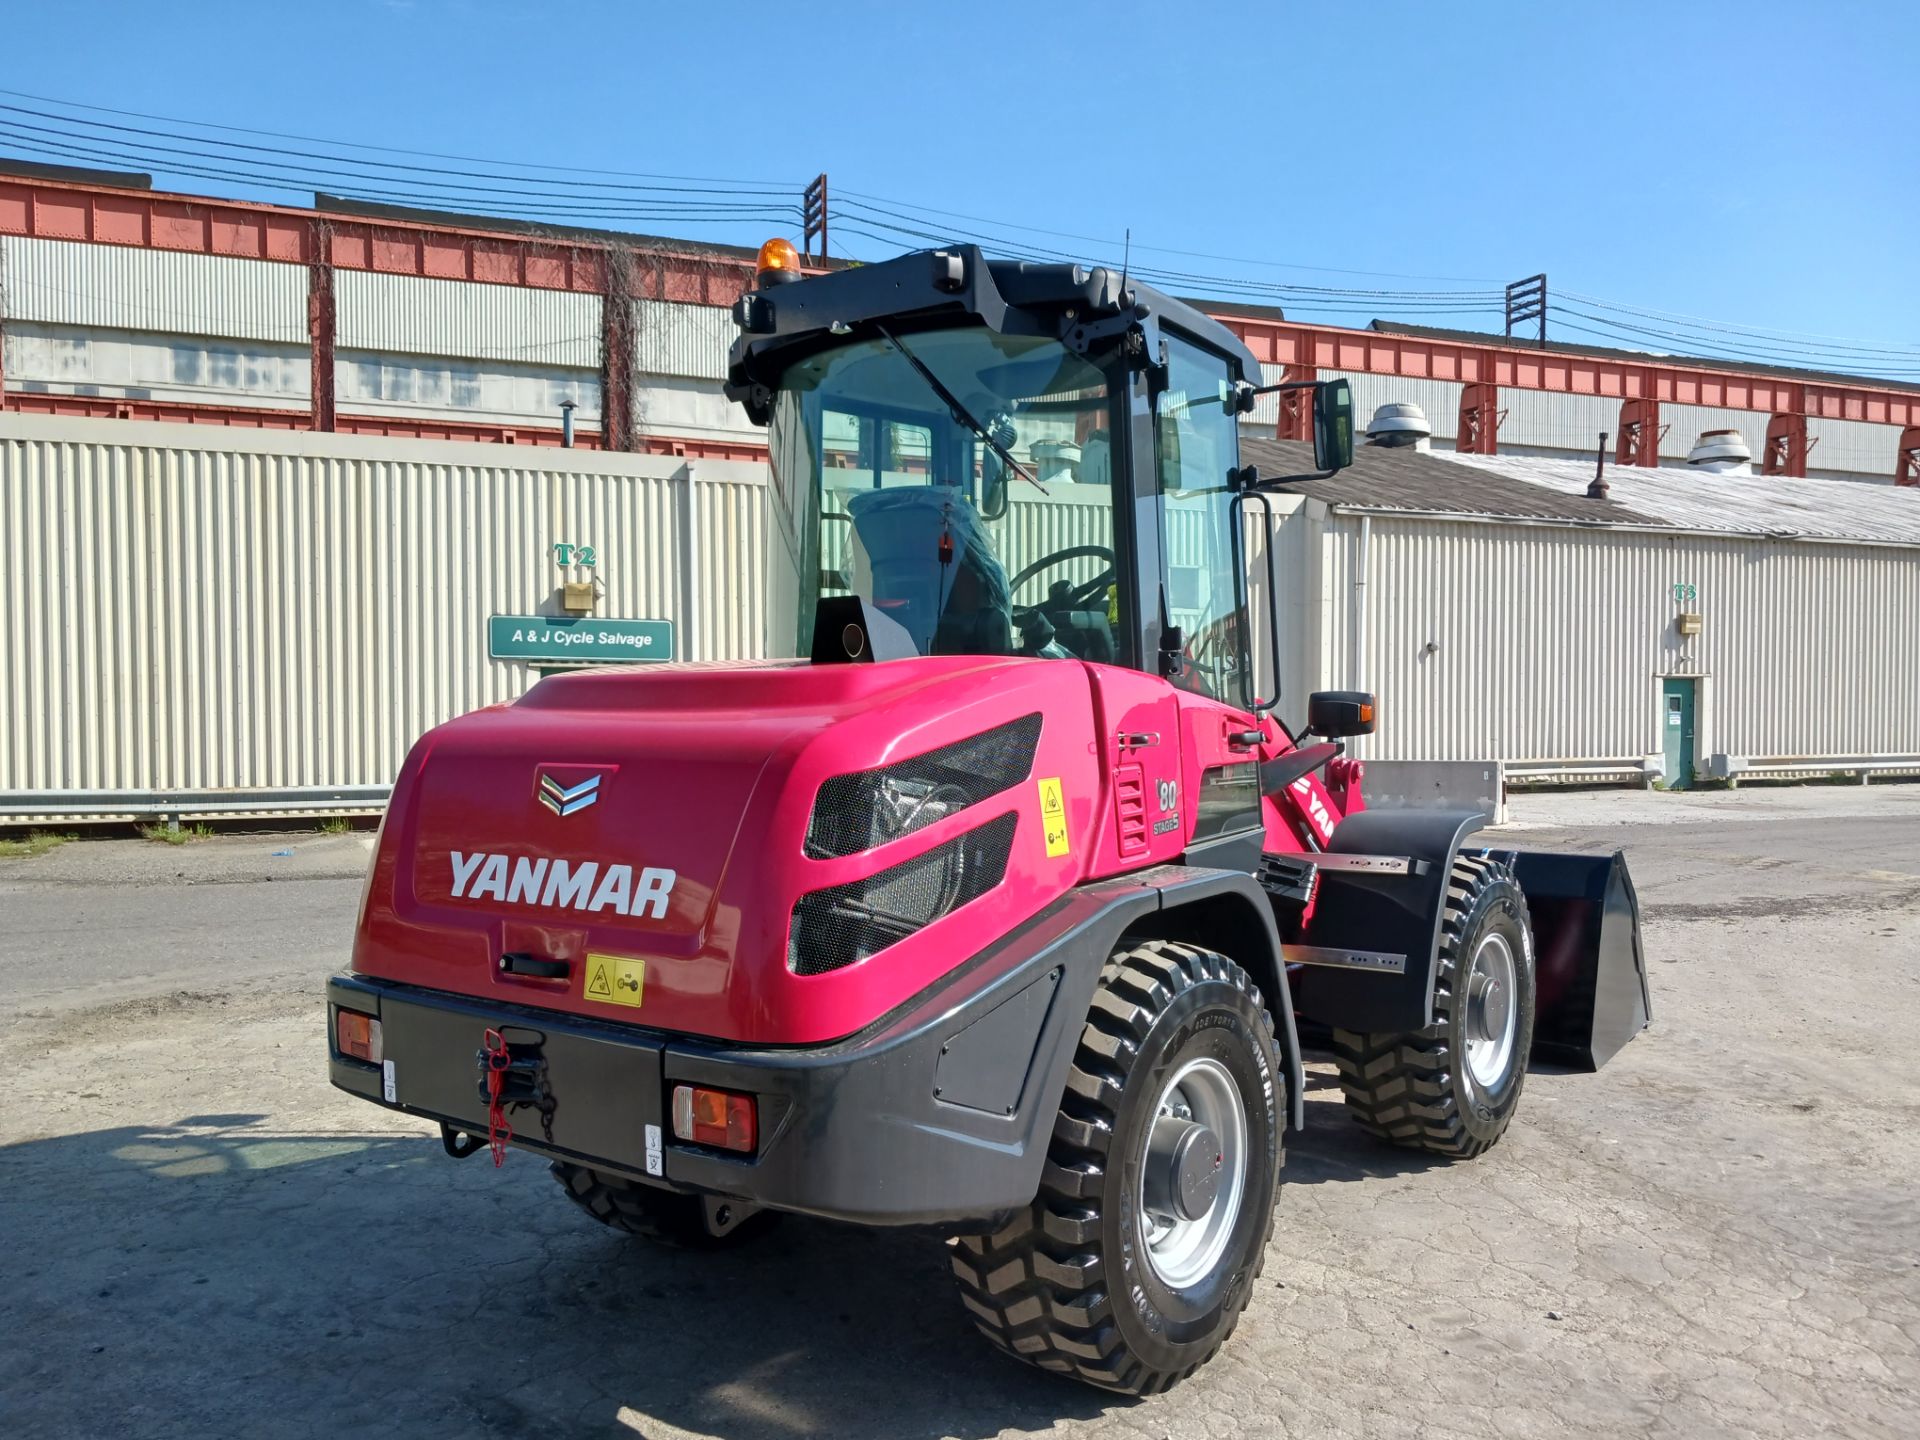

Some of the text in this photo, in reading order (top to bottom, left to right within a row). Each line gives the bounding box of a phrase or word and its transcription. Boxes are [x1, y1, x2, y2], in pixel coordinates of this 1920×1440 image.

[554, 543, 597, 566] T2
[1673, 583, 1697, 600] T3
[512, 629, 652, 648] A & J Cycle Salvage
[450, 851, 677, 919] YANMAR
